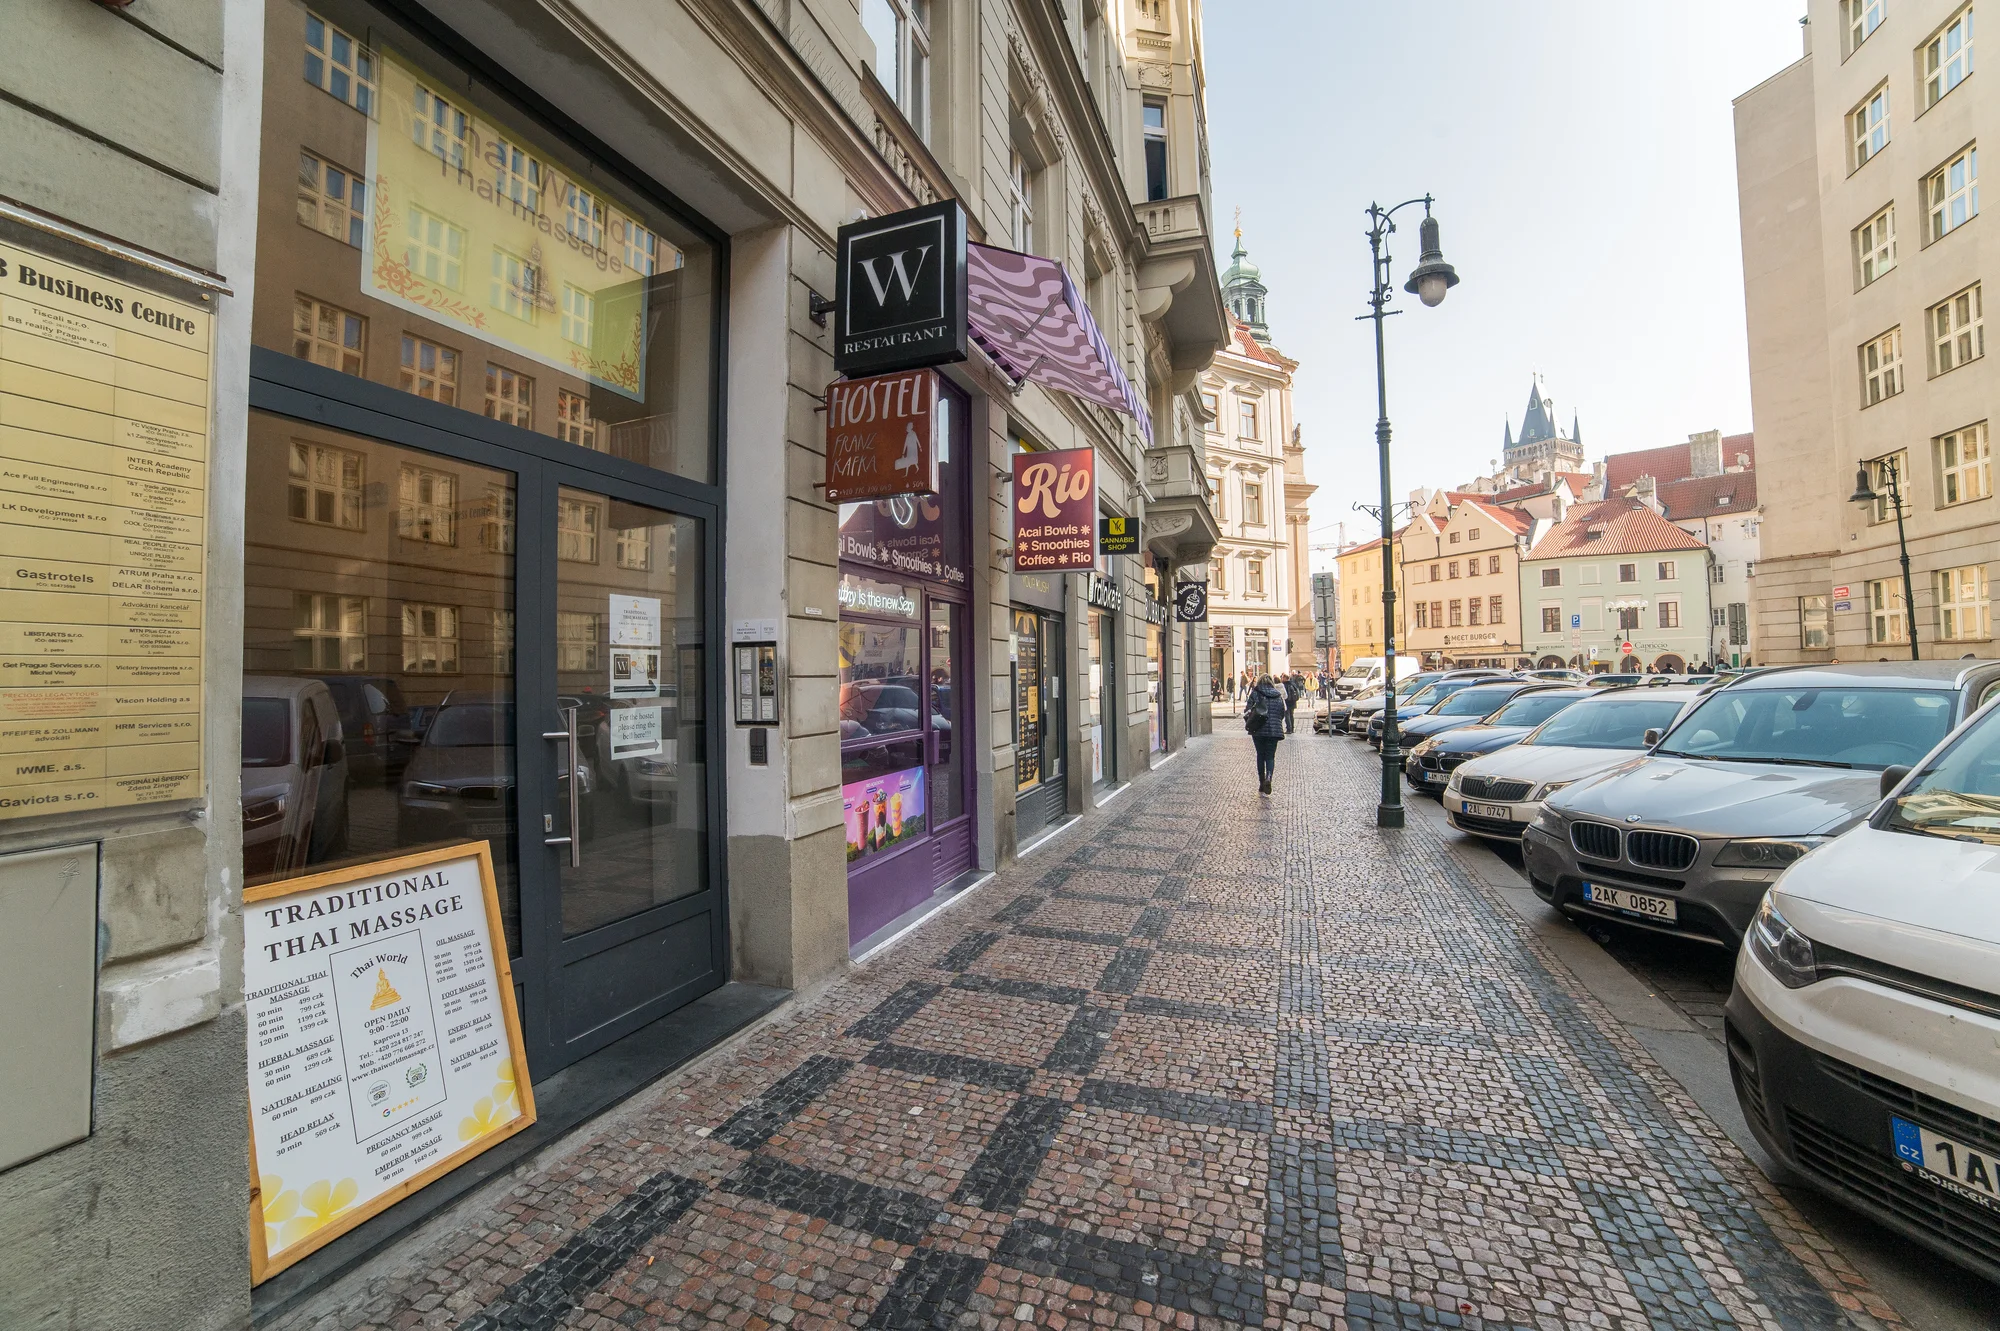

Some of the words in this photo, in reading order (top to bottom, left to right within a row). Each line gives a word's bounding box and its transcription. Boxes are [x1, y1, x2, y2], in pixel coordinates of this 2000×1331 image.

[433, 142, 500, 207] Thai
[513, 197, 622, 273] massage
[858, 244, 934, 307] W
[18, 263, 124, 314] Business
[132, 301, 196, 336] Centre
[33, 308, 64, 323] Tiscali
[66, 318, 90, 331] s.r.o.
[25, 320, 54, 335] reality
[56, 327, 88, 344] Prague
[90, 338, 109, 349] s.r.o.
[844, 325, 948, 355] RESTAURANT
[829, 374, 927, 429] HOSTEL
[832, 432, 878, 459] FRANZ
[127, 457, 153, 467] INTER
[155, 462, 191, 474] Academy
[128, 464, 154, 475] Czech
[156, 468, 190, 481] Republic
[831, 454, 878, 483] KAFKA
[3, 471, 21, 480] Ace
[41, 477, 89, 491] Engineering
[1018, 462, 1091, 519] Rio
[2, 503, 17, 511] LK
[20, 505, 85, 520] Development
[1018, 526, 1042, 539] Acai
[1044, 523, 1079, 537] Bowls
[1100, 536, 1134, 545] CANNABIS
[1031, 538, 1090, 552] Smoothies
[1108, 544, 1126, 552] SHOP
[848, 534, 878, 563] Bowls
[892, 549, 932, 576] Smoothies
[944, 564, 964, 584] Coffee
[1018, 554, 1055, 567] Coffee
[1072, 552, 1092, 564] Rio
[16, 568, 94, 584] Gastrotels
[112, 581, 143, 590] DELAR
[145, 583, 180, 594] Bohemia
[118, 569, 149, 578] ATRUM
[152, 571, 174, 581] Praha
[868, 590, 882, 608] the
[882, 595, 898, 610] new
[899, 596, 915, 616] Sexy
[1470, 632, 1497, 641] BURGER
[20, 662, 48, 672] Prague
[50, 662, 82, 670] Services
[115, 696, 144, 704] Viscon
[146, 695, 177, 704] Holding
[2, 729, 42, 738] PFEIFER
[52, 726, 100, 736] ZOLLMANN
[115, 723, 136, 731] HRM
[138, 721, 172, 730] Services
[174, 720, 192, 728] s.r.o.
[63, 762, 86, 771] a.s.
[0, 794, 60, 809] Gaviota
[64, 791, 100, 802] s.r.o.
[1469, 804, 1482, 815] 2AL
[1486, 806, 1506, 818] 0747
[264, 871, 449, 929] TRADITIONAL
[1594, 886, 1620, 906] 2AK
[1630, 894, 1669, 916] 0852
[264, 926, 340, 963] THAI
[349, 894, 464, 940] MASSAGE
[448, 930, 476, 943] MASSAGE
[350, 957, 375, 980] Thai
[376, 953, 409, 965] World
[246, 976, 306, 1002] TRADITIONAL
[306, 969, 329, 984] THAI
[269, 985, 311, 1004] MASSAGE
[459, 978, 487, 996] MASSAGE
[256, 1011, 267, 1020] 30
[269, 1005, 283, 1016] min
[299, 996, 312, 1005] 499
[313, 992, 325, 1002] czk
[258, 1020, 268, 1029] 60
[270, 1015, 284, 1025] min
[300, 1004, 313, 1014] 799
[314, 1000, 326, 1010] czk
[364, 1014, 387, 1030] OPEN
[388, 1006, 412, 1021] DAILY
[259, 1029, 269, 1039] 90
[271, 1024, 285, 1034] min
[297, 1013, 314, 1024] 1199
[315, 1009, 327, 1019] czk
[259, 1037, 274, 1048] 120
[276, 1031, 290, 1042] min
[300, 1021, 317, 1033] 1399
[317, 1017, 330, 1027] czk
[369, 1024, 386, 1036] 9:00
[390, 1014, 410, 1028] 22:00
[473, 1012, 492, 1028] RELAX
[258, 1050, 294, 1069] HERBAL
[294, 1034, 335, 1054] MASSAGE
[373, 1030, 400, 1047] Kaprova
[265, 1069, 275, 1079] 30
[276, 1063, 290, 1075] min
[306, 1051, 319, 1062] 689
[320, 1047, 332, 1057] czk
[351, 1043, 436, 1084] www.thaiworldmassage.cz
[449, 1049, 479, 1067] NATURAL
[480, 1038, 499, 1055] RELAX
[265, 1078, 276, 1088] 60
[278, 1072, 292, 1083] min
[304, 1060, 321, 1072] 1299
[321, 1055, 333, 1066] czk
[261, 1090, 304, 1115] NATURAL
[304, 1074, 343, 1099] HEALING
[280, 1125, 306, 1144] HEAD
[306, 1112, 336, 1132] RELAX
[366, 1126, 411, 1155] PREGNANCY
[410, 1110, 443, 1134] MASSAGE
[374, 1151, 411, 1177] EMPEROR
[410, 1134, 443, 1159] MASSAGE
[1900, 1144, 1920, 1160] CZ
[1935, 1141, 2000, 1199] 1A
